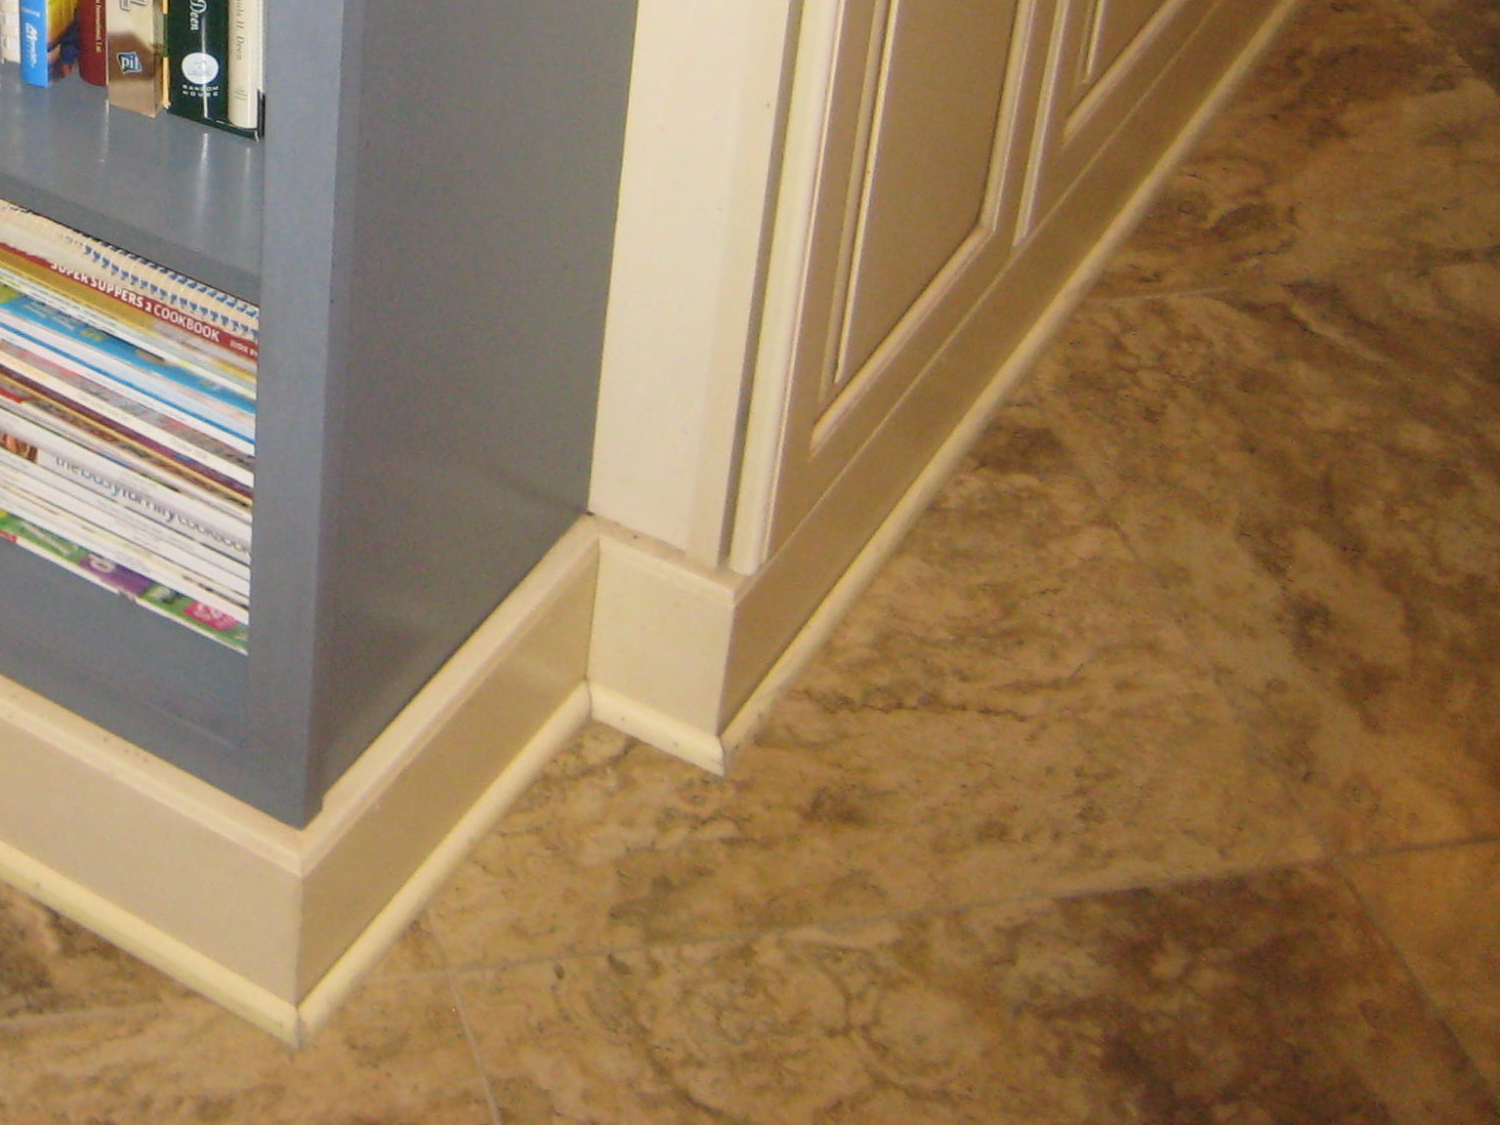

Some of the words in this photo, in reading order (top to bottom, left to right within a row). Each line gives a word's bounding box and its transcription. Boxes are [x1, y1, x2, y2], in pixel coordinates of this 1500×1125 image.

[236, 36, 246, 60] Deen
[91, 277, 144, 308] SUPPERS
[145, 301, 153, 312] 2
[153, 305, 220, 343] COOKBOOK
